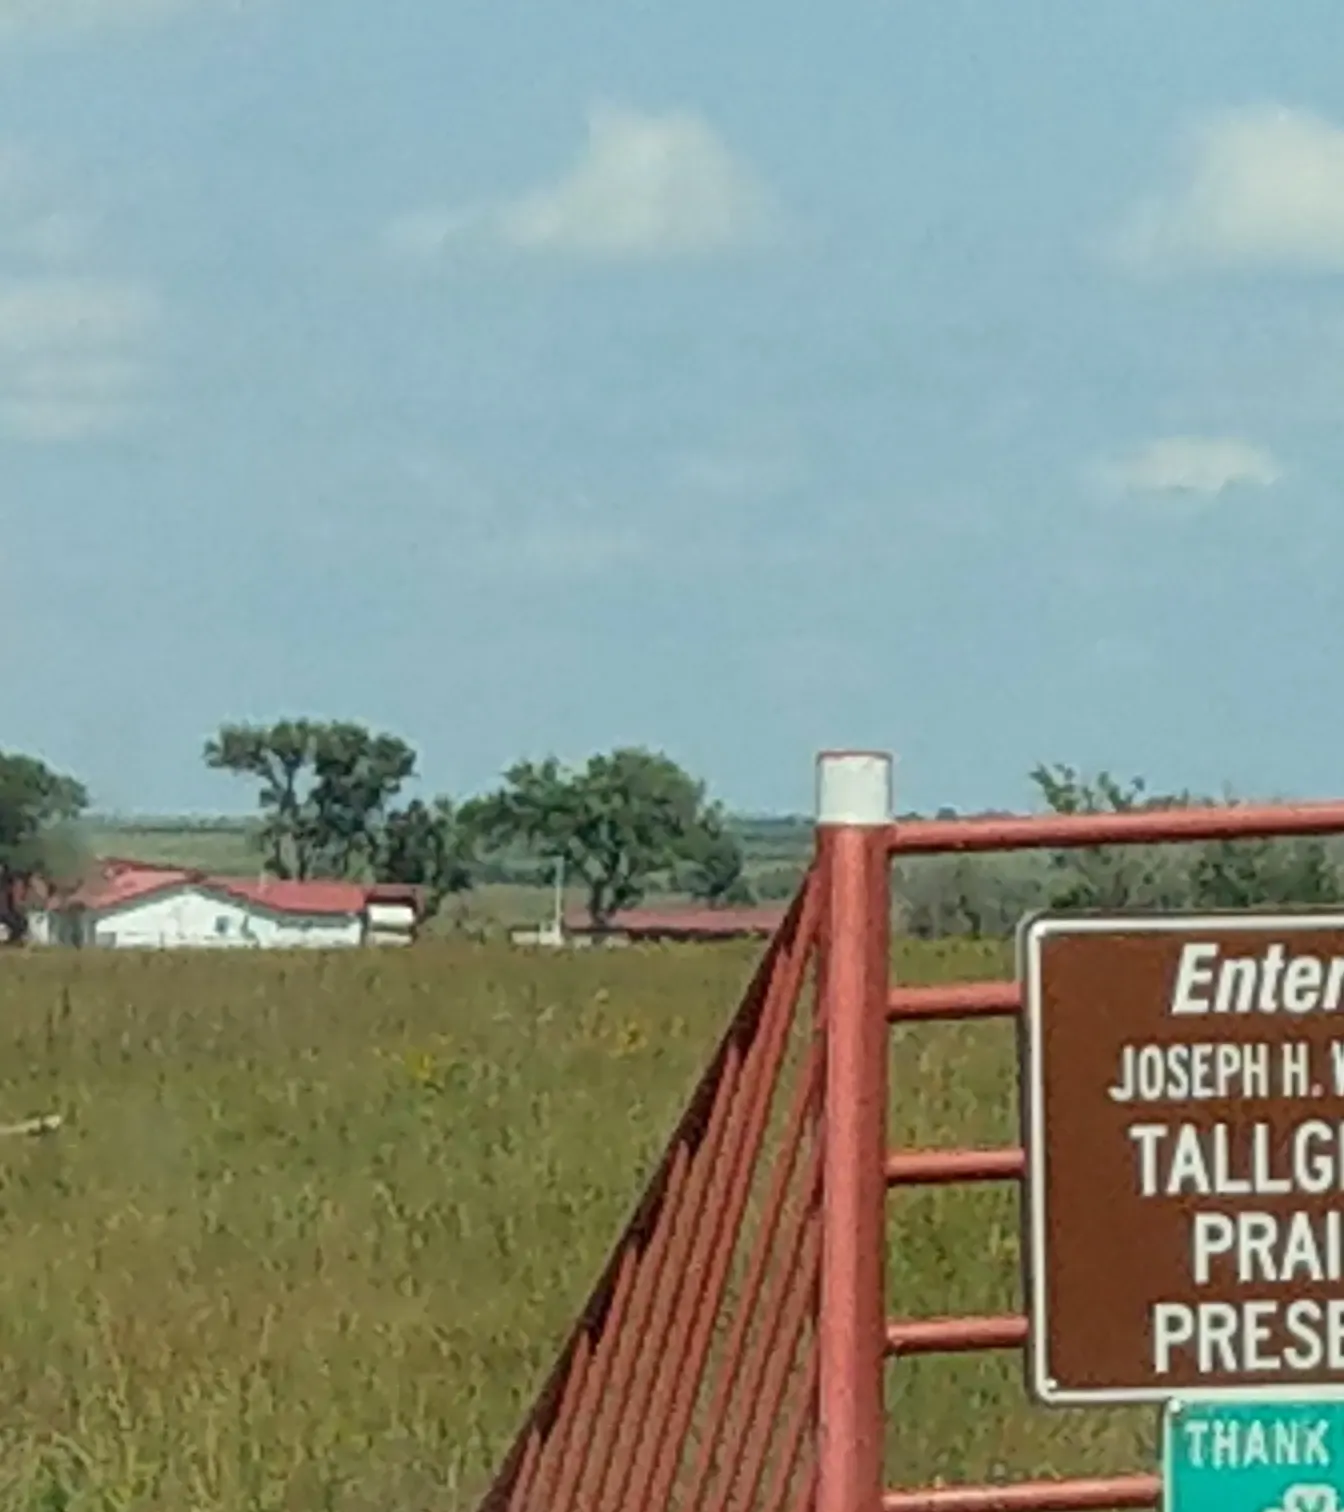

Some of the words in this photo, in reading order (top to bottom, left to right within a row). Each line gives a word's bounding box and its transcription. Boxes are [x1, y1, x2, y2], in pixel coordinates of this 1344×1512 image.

[1109, 1043, 1268, 1100] JOSEPH
[1282, 1042, 1322, 1097] H.
[1184, 1419, 1329, 1470] THANK
